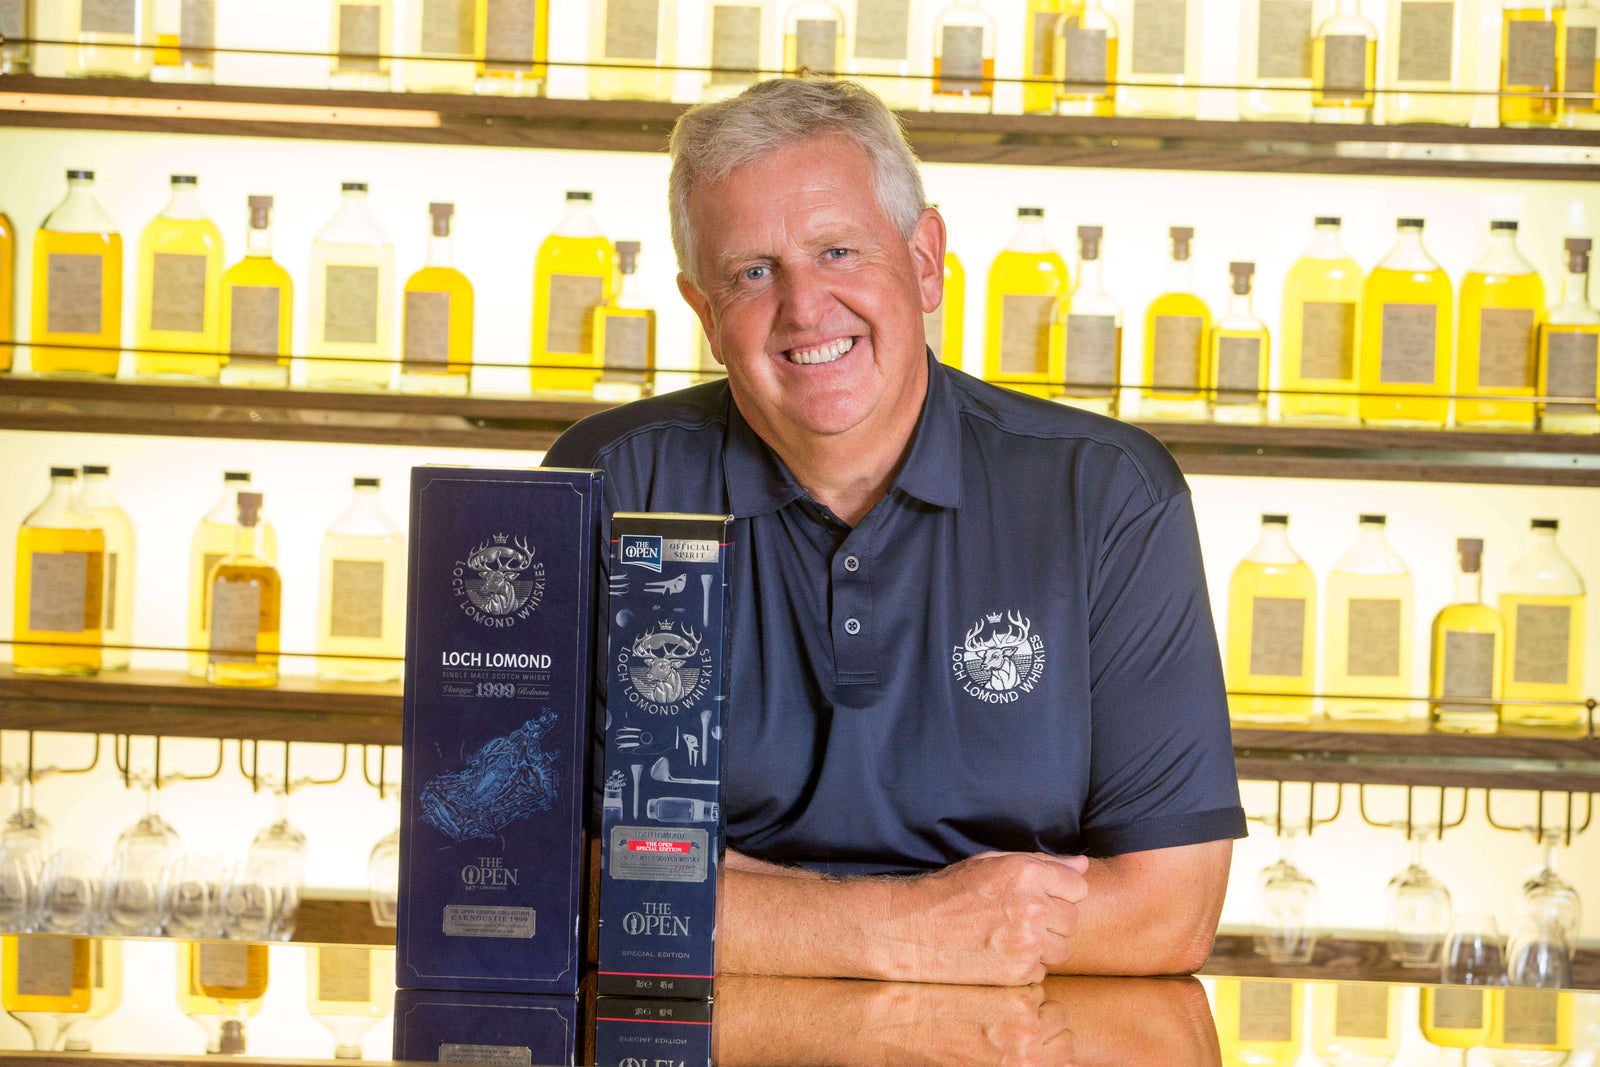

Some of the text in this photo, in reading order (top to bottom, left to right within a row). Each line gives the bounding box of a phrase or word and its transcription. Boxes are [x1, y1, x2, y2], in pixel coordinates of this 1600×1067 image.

[625, 545, 659, 558] OPEN
[669, 543, 711, 551] OFFICIAL
[673, 551, 705, 559] SPIRIT
[452, 560, 546, 628] LOCH LOMOND WHISKIES
[442, 651, 552, 669] LOCH LOMOND
[952, 634, 1046, 704] LOCH LOMOND WHISKIES
[442, 671, 467, 679] SINGLE
[491, 672, 520, 680] SCOTCH
[522, 673, 551, 681] WHISKY
[617, 646, 712, 716] LOCH LOMOND WHISKIES
[442, 684, 474, 696] Vintage
[475, 681, 516, 699] 1999
[478, 857, 504, 868] THE
[461, 864, 520, 886] OPEN
[642, 902, 672, 915] THE
[450, 914, 528, 923] CARNOUSTIE 1999
[622, 911, 691, 937] OPEN
[621, 950, 690, 960] SPECIAL EDITION
